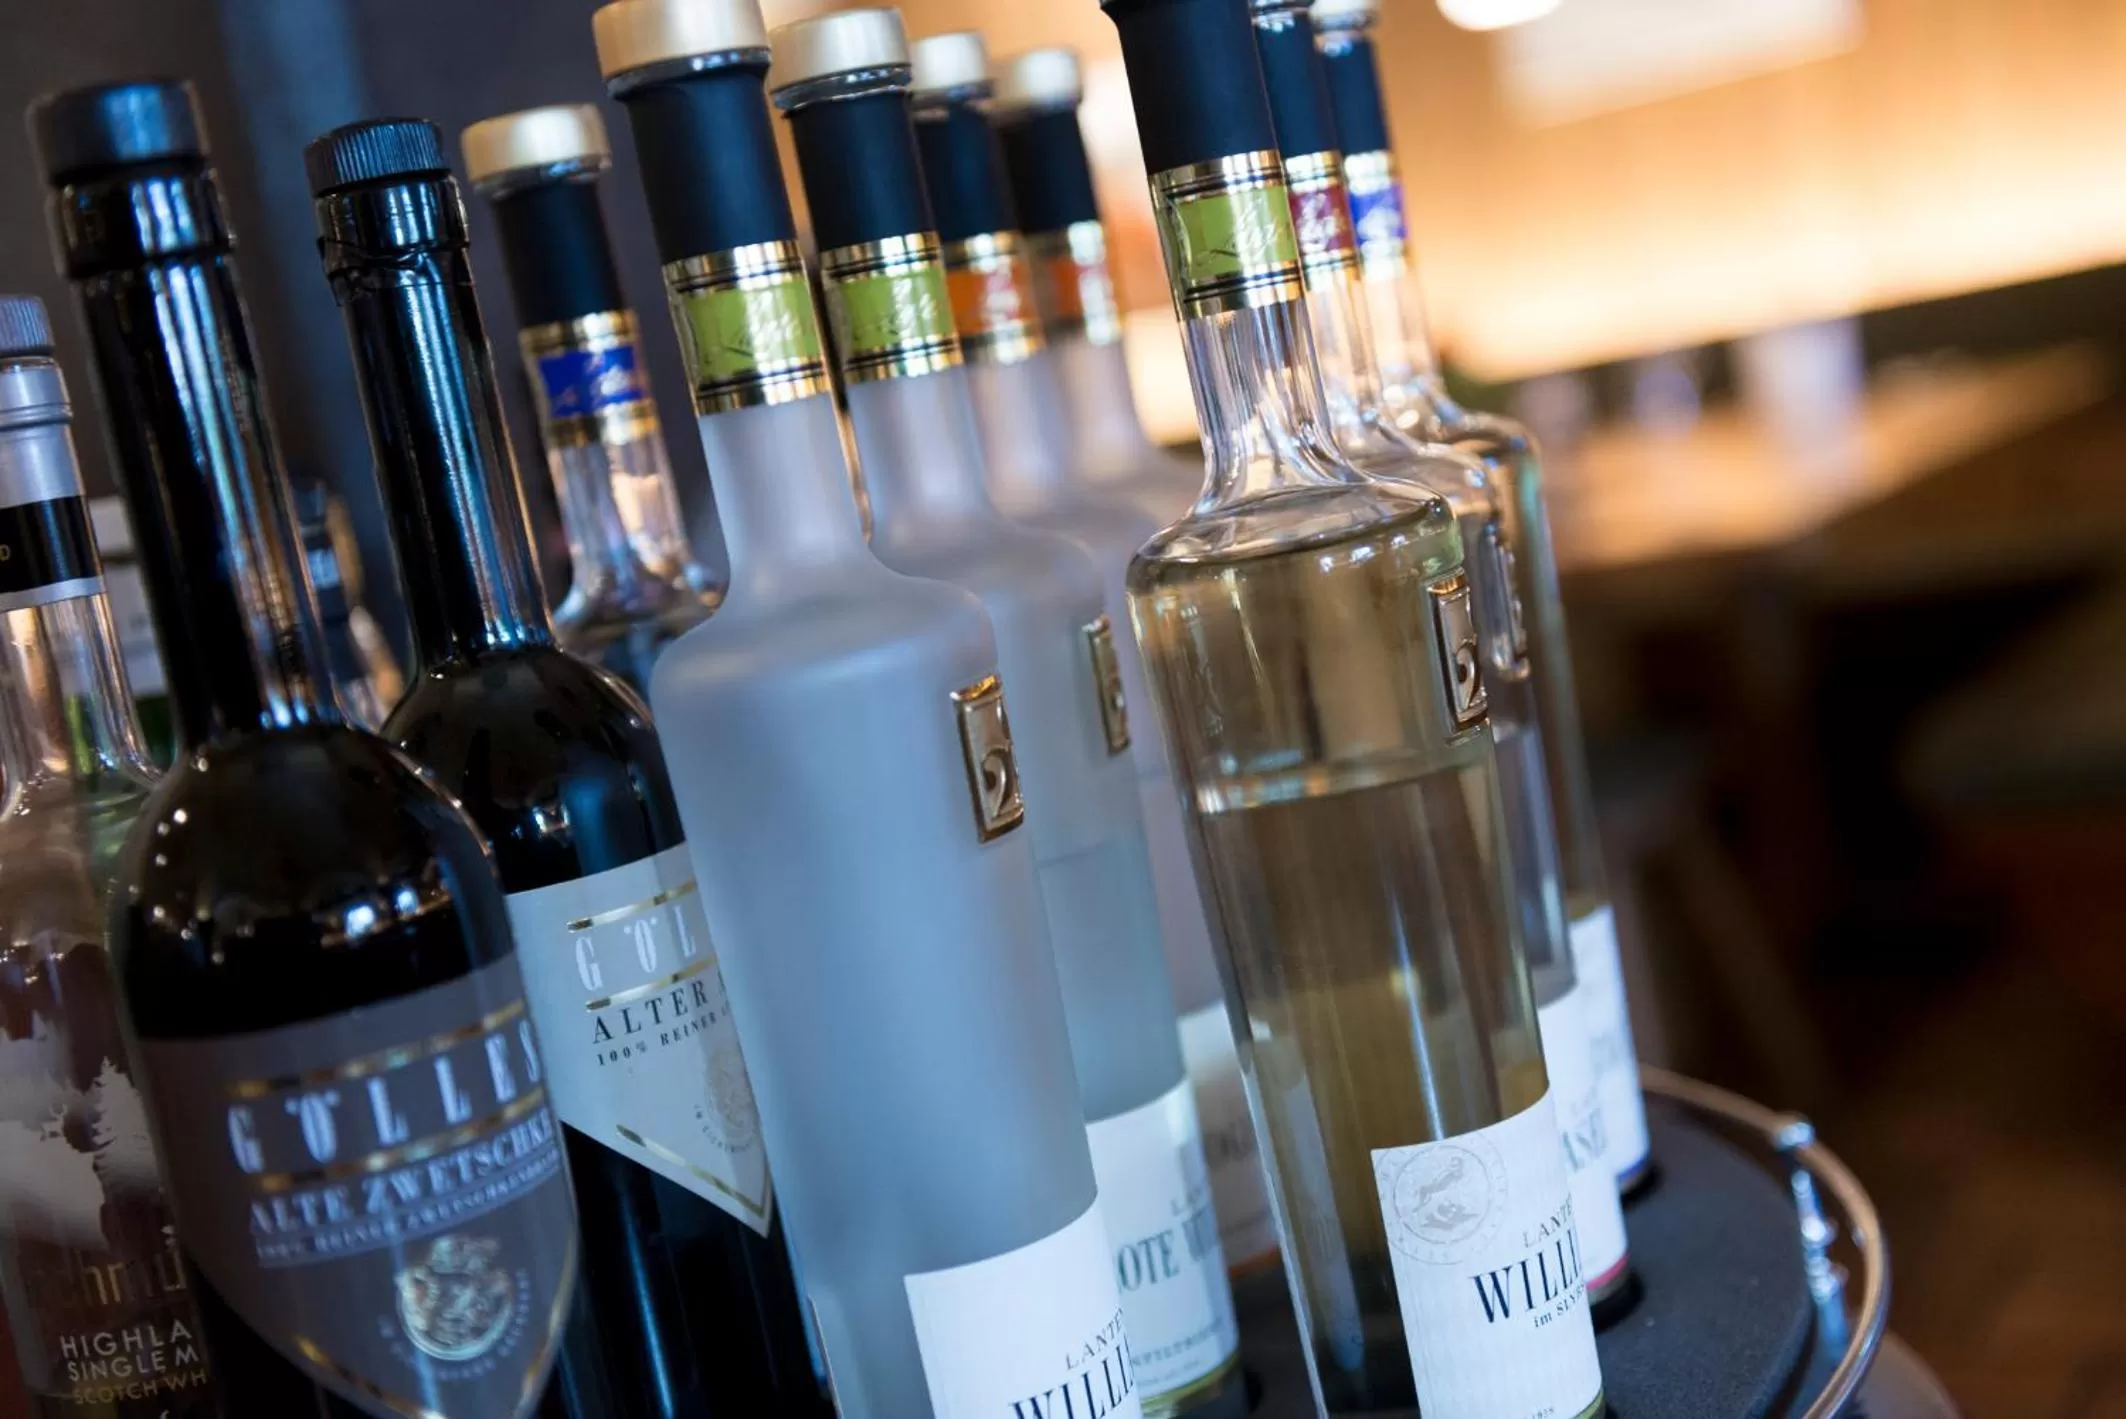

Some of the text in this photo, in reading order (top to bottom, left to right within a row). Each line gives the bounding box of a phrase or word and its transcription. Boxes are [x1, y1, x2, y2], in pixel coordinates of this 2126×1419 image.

[592, 979, 709, 1045] ALTER
[597, 1040, 648, 1067] 100%
[660, 1011, 717, 1047] REINER
[1115, 1227, 1181, 1296] OTE
[1468, 1229, 1579, 1324] WILLI
[59, 1318, 193, 1360] HIGHLA
[67, 1343, 200, 1383] SINGLE M
[72, 1367, 208, 1405] SCOTCH WH
